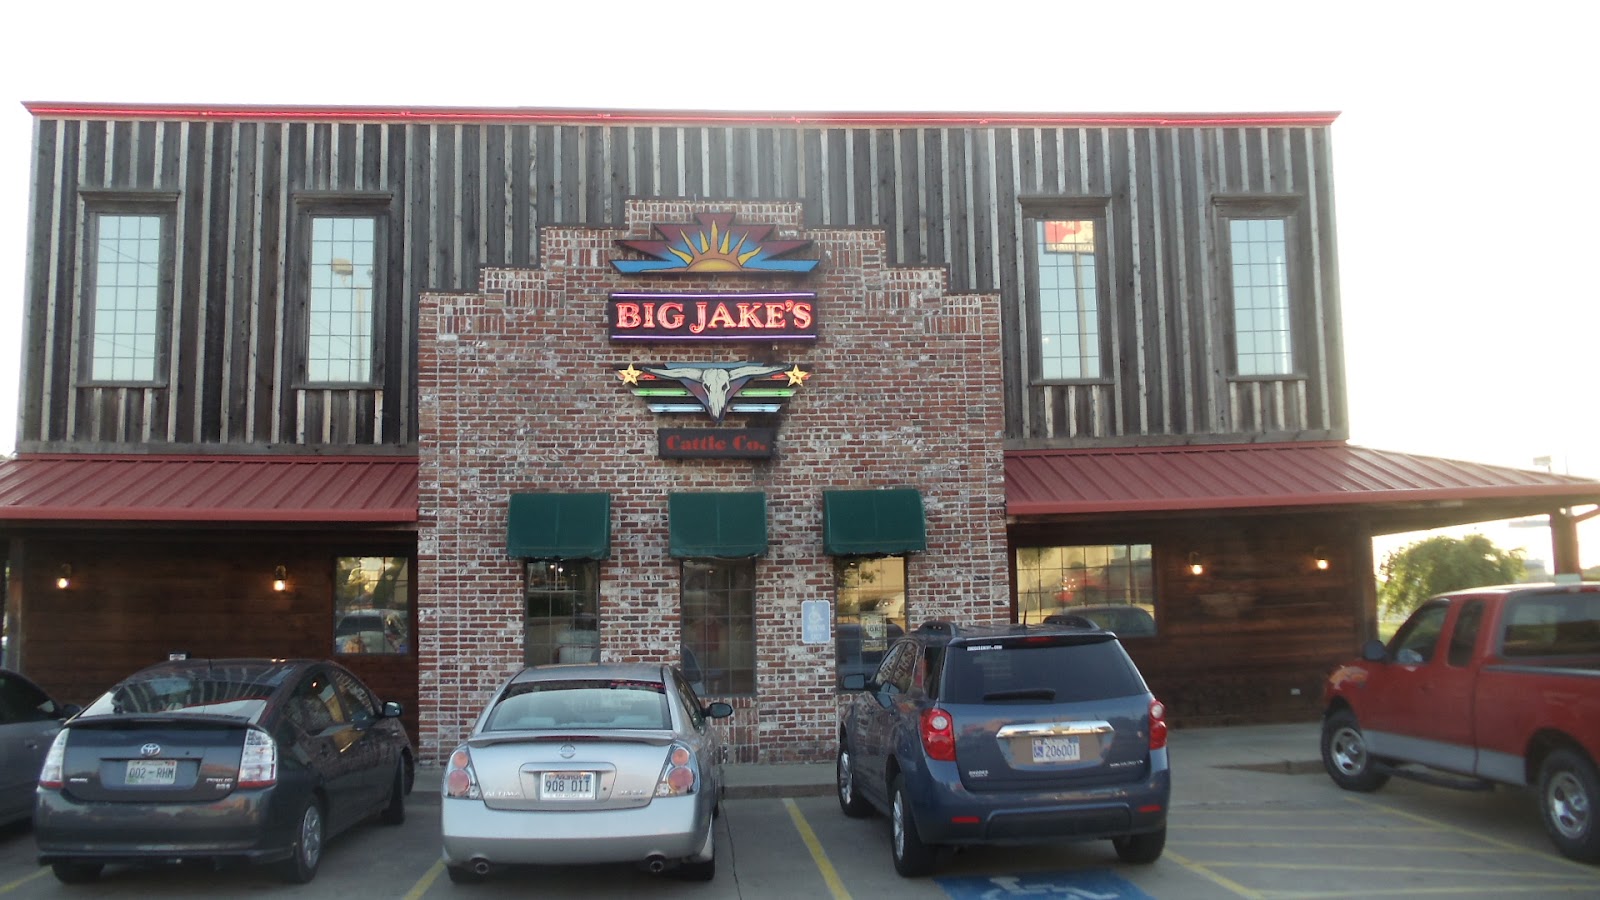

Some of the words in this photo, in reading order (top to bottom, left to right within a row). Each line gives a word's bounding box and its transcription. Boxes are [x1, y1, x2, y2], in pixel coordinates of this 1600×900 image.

[616, 302, 685, 329] BIG
[689, 299, 812, 334] JAKE'S
[666, 434, 727, 451] Cattle
[732, 434, 767, 451] Co.
[1045, 744, 1077, 757] 206001
[545, 780, 565, 792] 908
